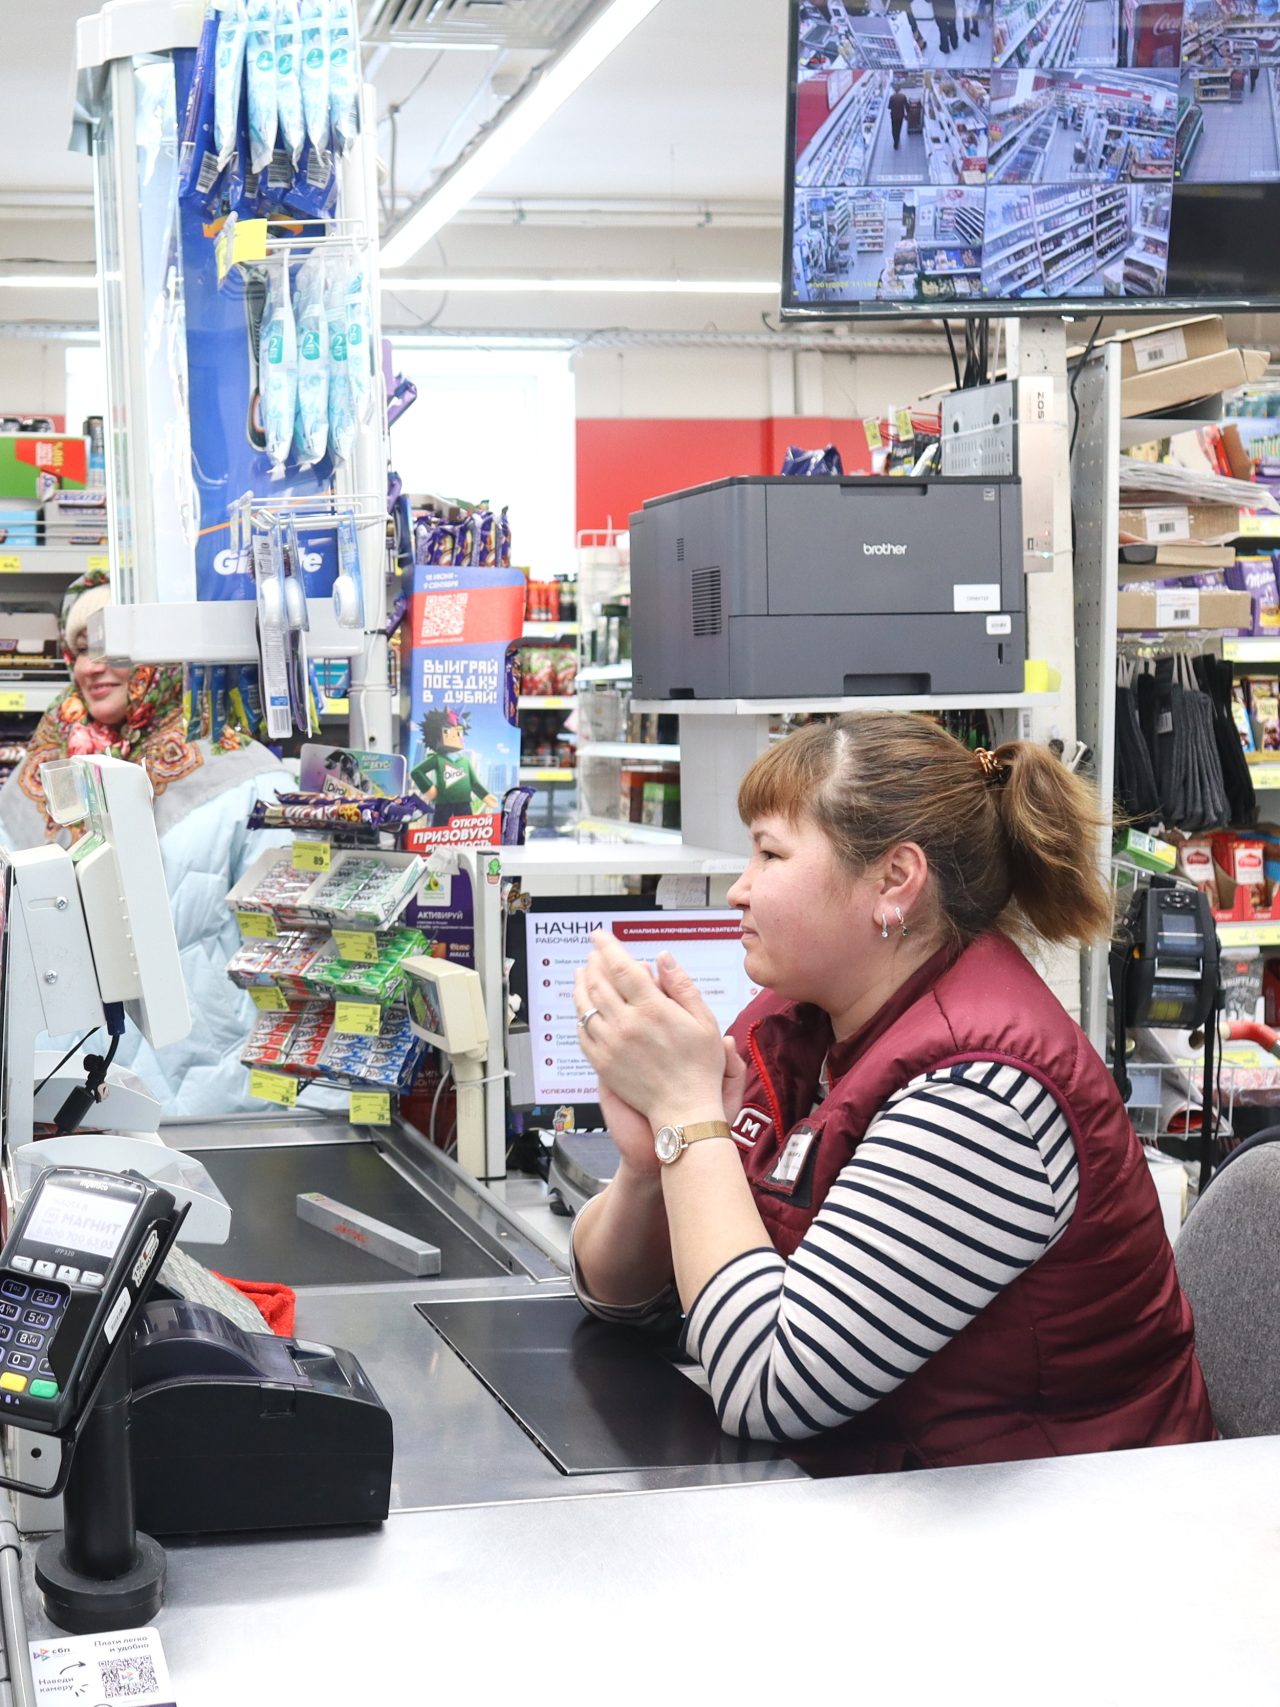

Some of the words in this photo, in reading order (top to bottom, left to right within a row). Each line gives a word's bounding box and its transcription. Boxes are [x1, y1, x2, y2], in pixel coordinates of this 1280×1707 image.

[349, 325, 357, 335] 2
[270, 336, 279, 350] 2
[305, 333, 315, 349] 2
[334, 335, 344, 349] 2
[862, 543, 908, 555] brother
[423, 659, 499, 674] ВЫИГРАЙ
[423, 674, 498, 690] ПОЕЗДКУ
[423, 690, 434, 703] В
[442, 689, 498, 704] ДУБАЙ!
[445, 768, 464, 779] Dirol
[327, 782, 347, 795] Dirol
[451, 815, 493, 828] ОТКРОЙ
[413, 827, 494, 844] ПРИЗОВУЮ
[313, 856, 324, 866] 89
[417, 910, 463, 920] АКТИВИРУЙ
[534, 921, 603, 935] НАЧНИ
[535, 936, 580, 944] РАБОЧИЙ
[61, 1213, 122, 1235] МАГНИТ
[94, 1640, 122, 1648] Плати
[123, 1636, 148, 1645] легко
[117, 1643, 150, 1653] удобно
[38, 1676, 75, 1686] Наведи
[39, 1684, 74, 1694] камеру
